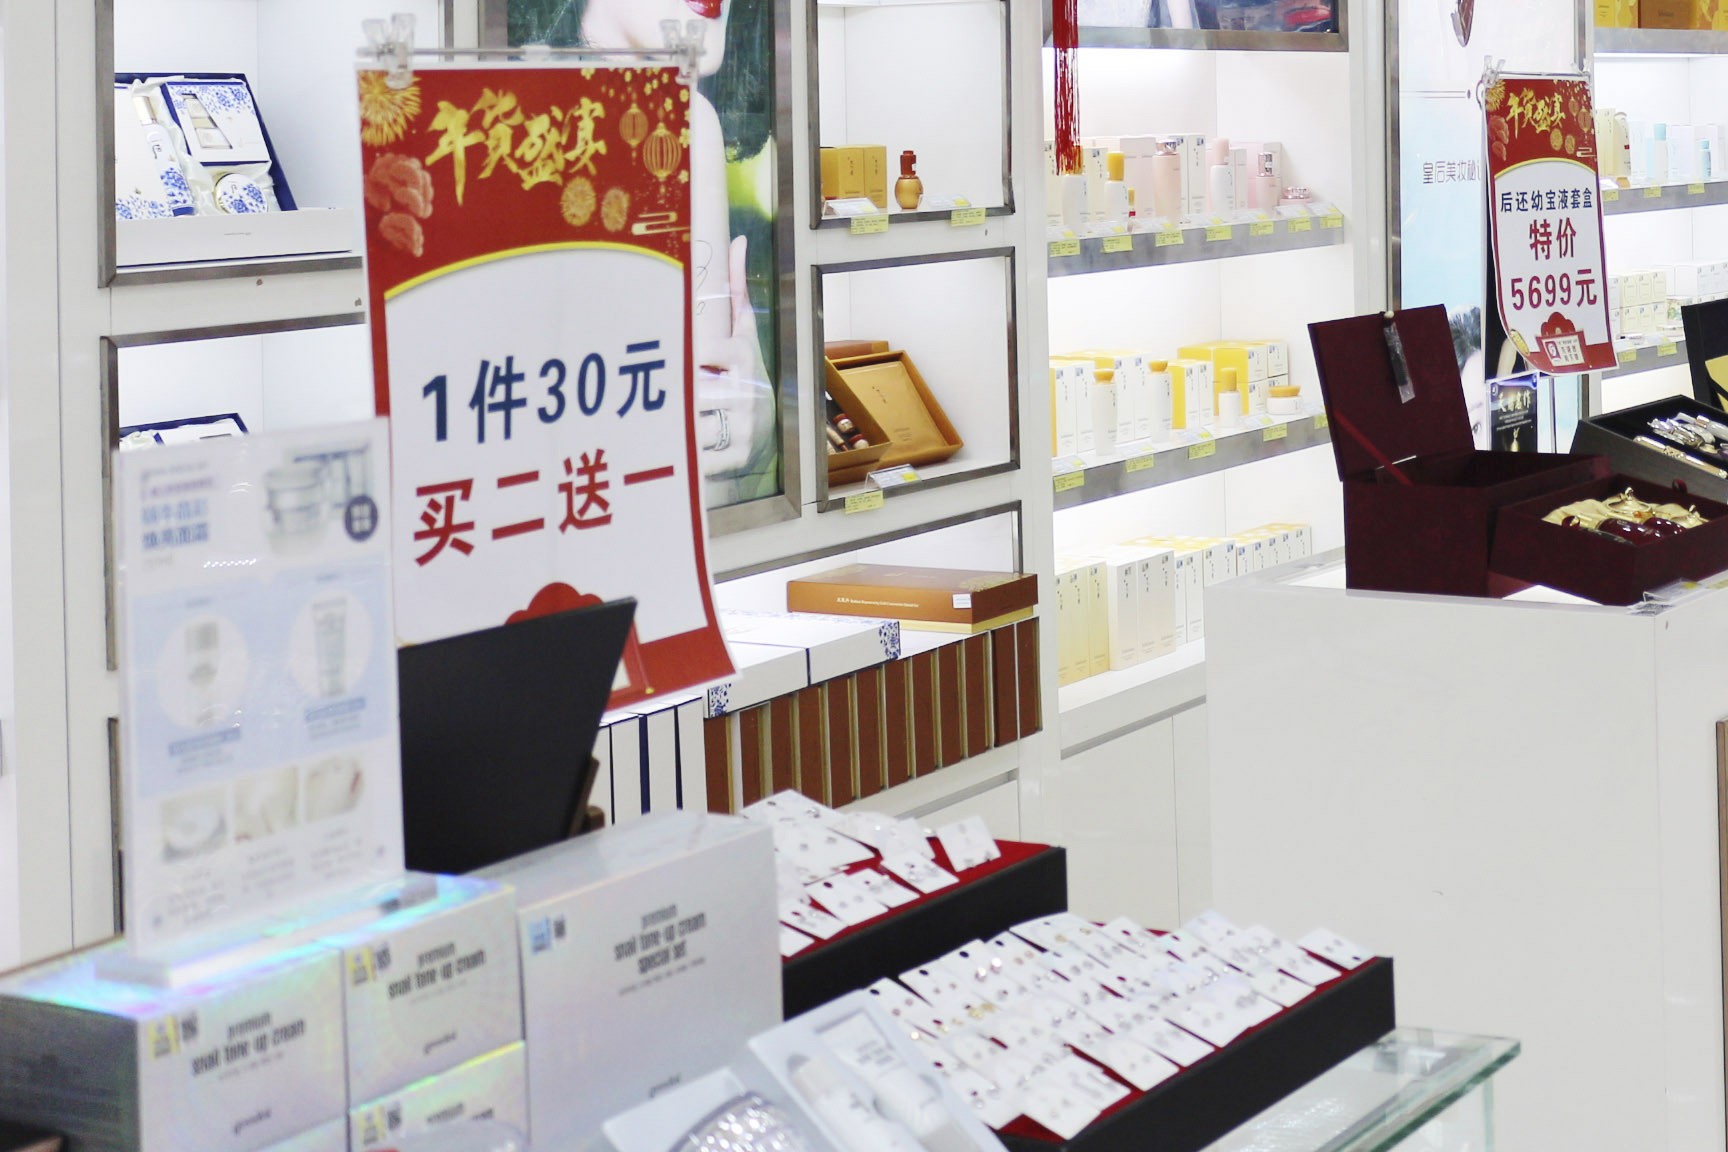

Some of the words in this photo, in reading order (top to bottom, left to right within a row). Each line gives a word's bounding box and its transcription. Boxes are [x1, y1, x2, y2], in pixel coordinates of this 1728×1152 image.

[1500, 187, 1593, 214] 后还幼宝液套盒
[1529, 216, 1577, 262] 特价
[1510, 268, 1598, 311] 5699元
[422, 339, 668, 444] 1件30元
[413, 448, 675, 568] 买二送一
